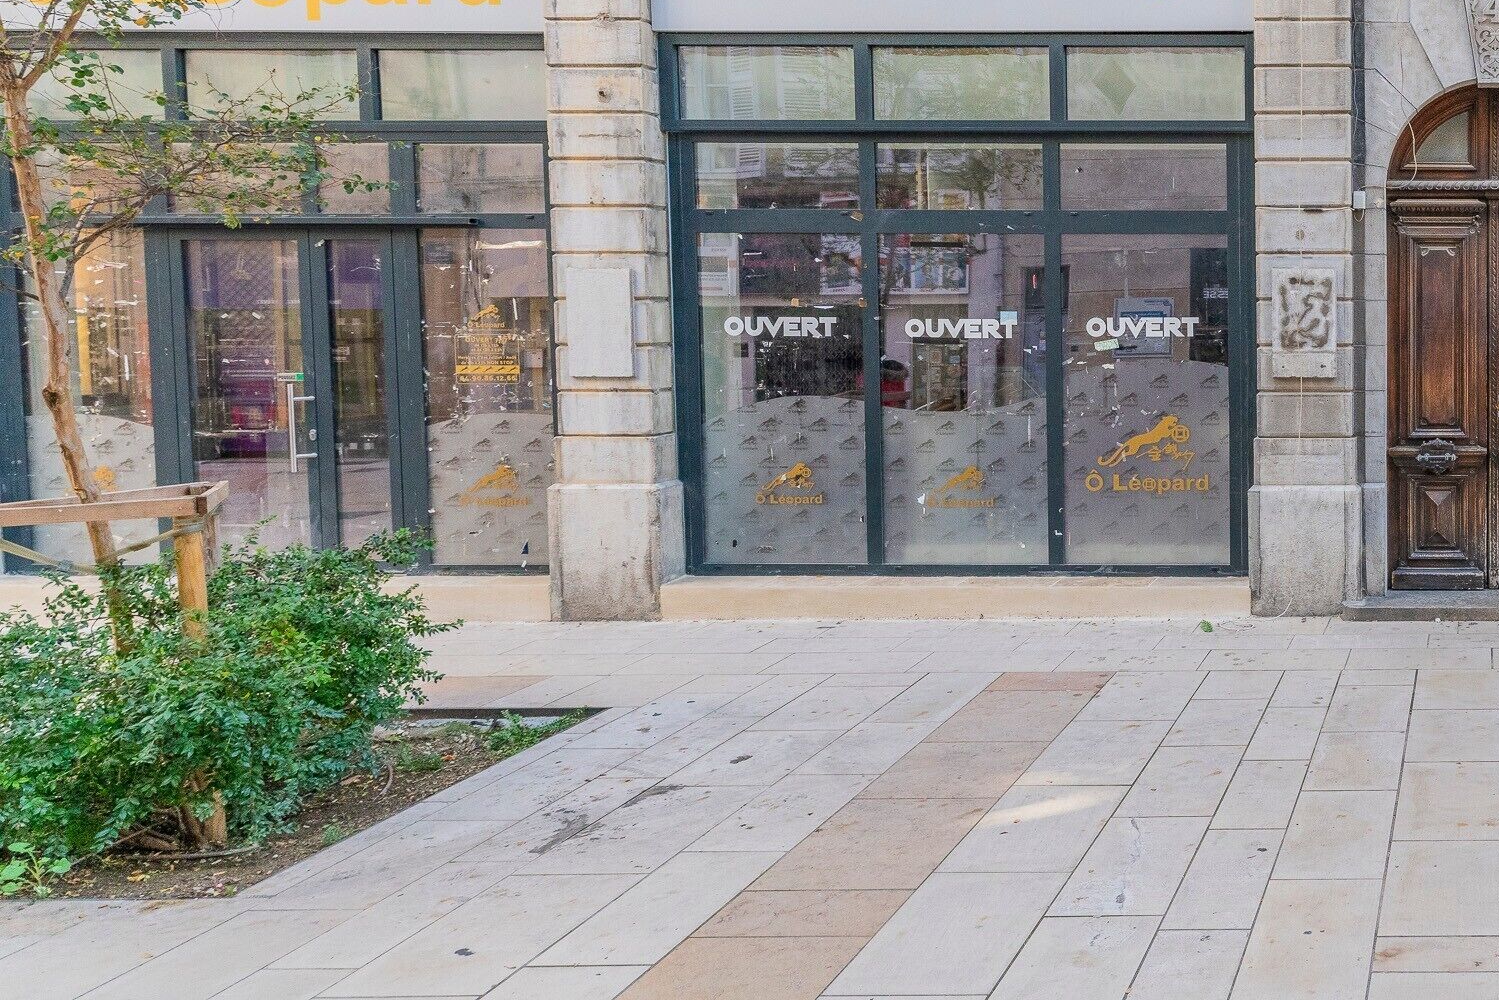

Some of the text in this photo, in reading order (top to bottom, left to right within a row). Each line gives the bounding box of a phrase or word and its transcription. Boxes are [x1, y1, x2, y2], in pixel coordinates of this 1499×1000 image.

[723, 315, 838, 338] OUVERT
[904, 317, 1018, 340] OUVERT
[1085, 316, 1200, 339] OUVERT
[1084, 468, 1210, 495] Ô Léopard
[769, 493, 823, 506] Léopard
